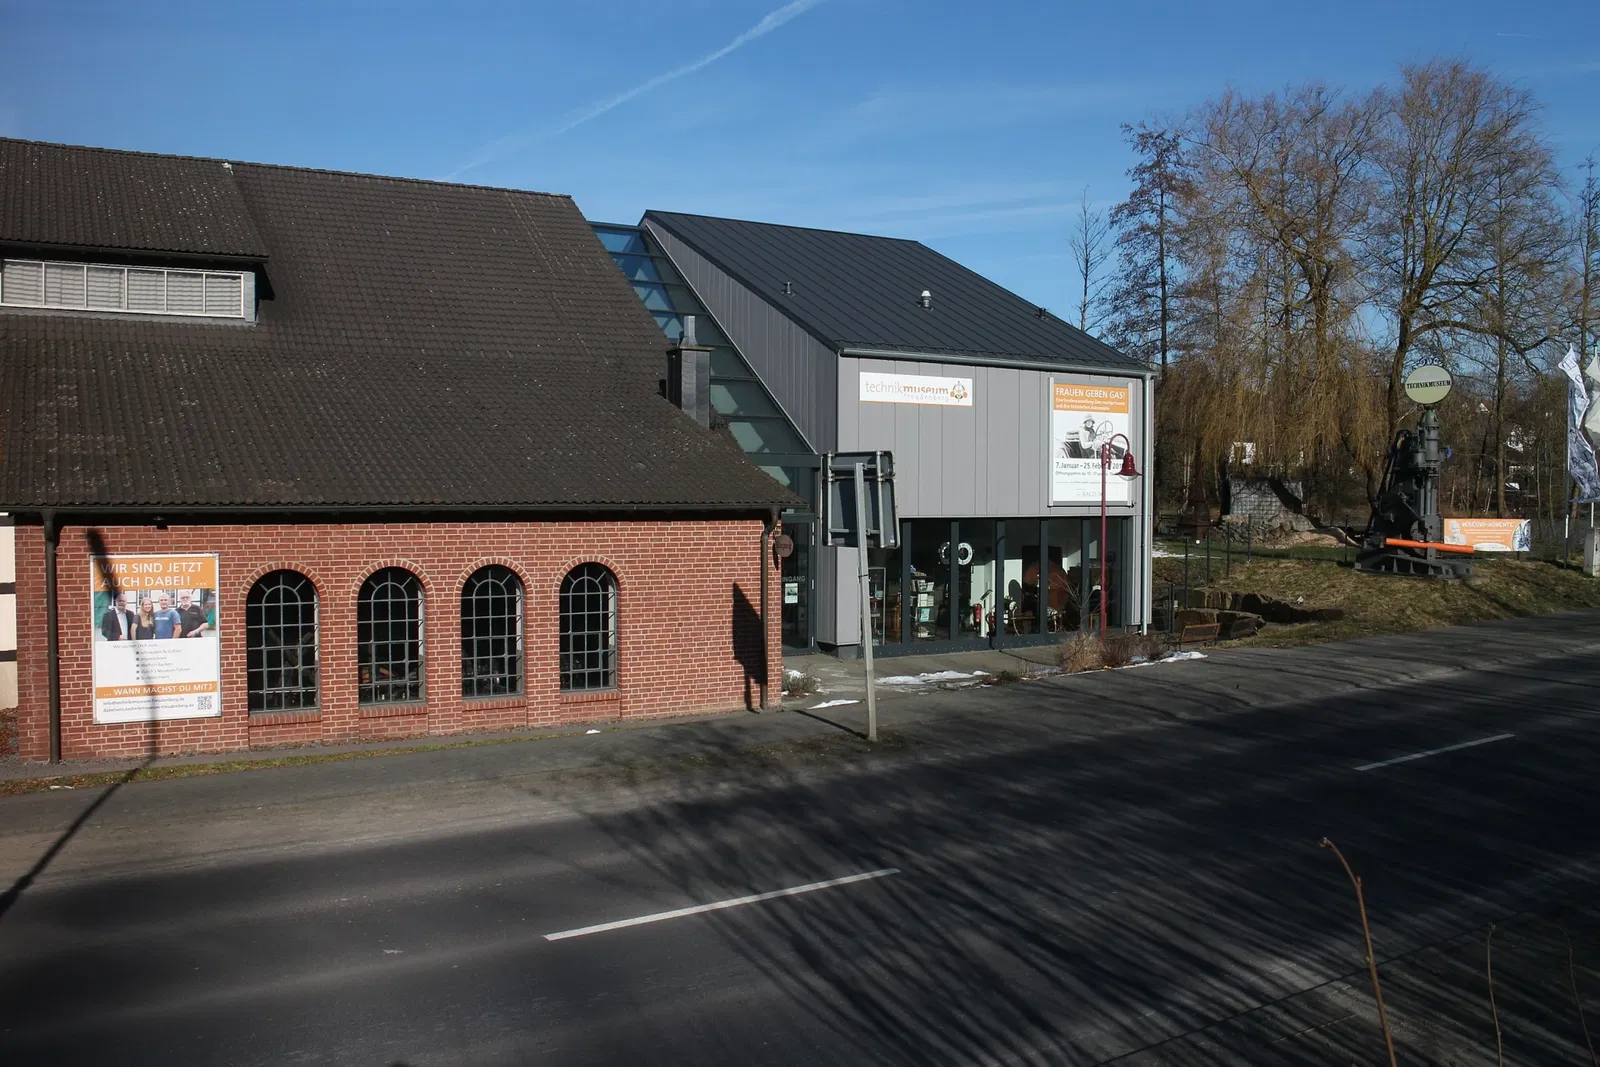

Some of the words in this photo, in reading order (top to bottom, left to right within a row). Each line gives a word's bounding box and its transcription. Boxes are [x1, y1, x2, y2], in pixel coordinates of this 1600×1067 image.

[865, 381, 949, 395] technikmuseum
[1406, 380, 1451, 389] TECHNIKMUSEUM
[1055, 388, 1084, 397] FRAUEN
[1085, 389, 1108, 398] GEBEN
[101, 563, 128, 574] WIR
[131, 563, 163, 573] SIND
[167, 562, 204, 573] JETZT
[101, 577, 140, 588] AUCH
[113, 687, 141, 696] WANN
[143, 685, 177, 694] MACHST
[179, 684, 191, 693] DU
[193, 683, 213, 691] MIT?
